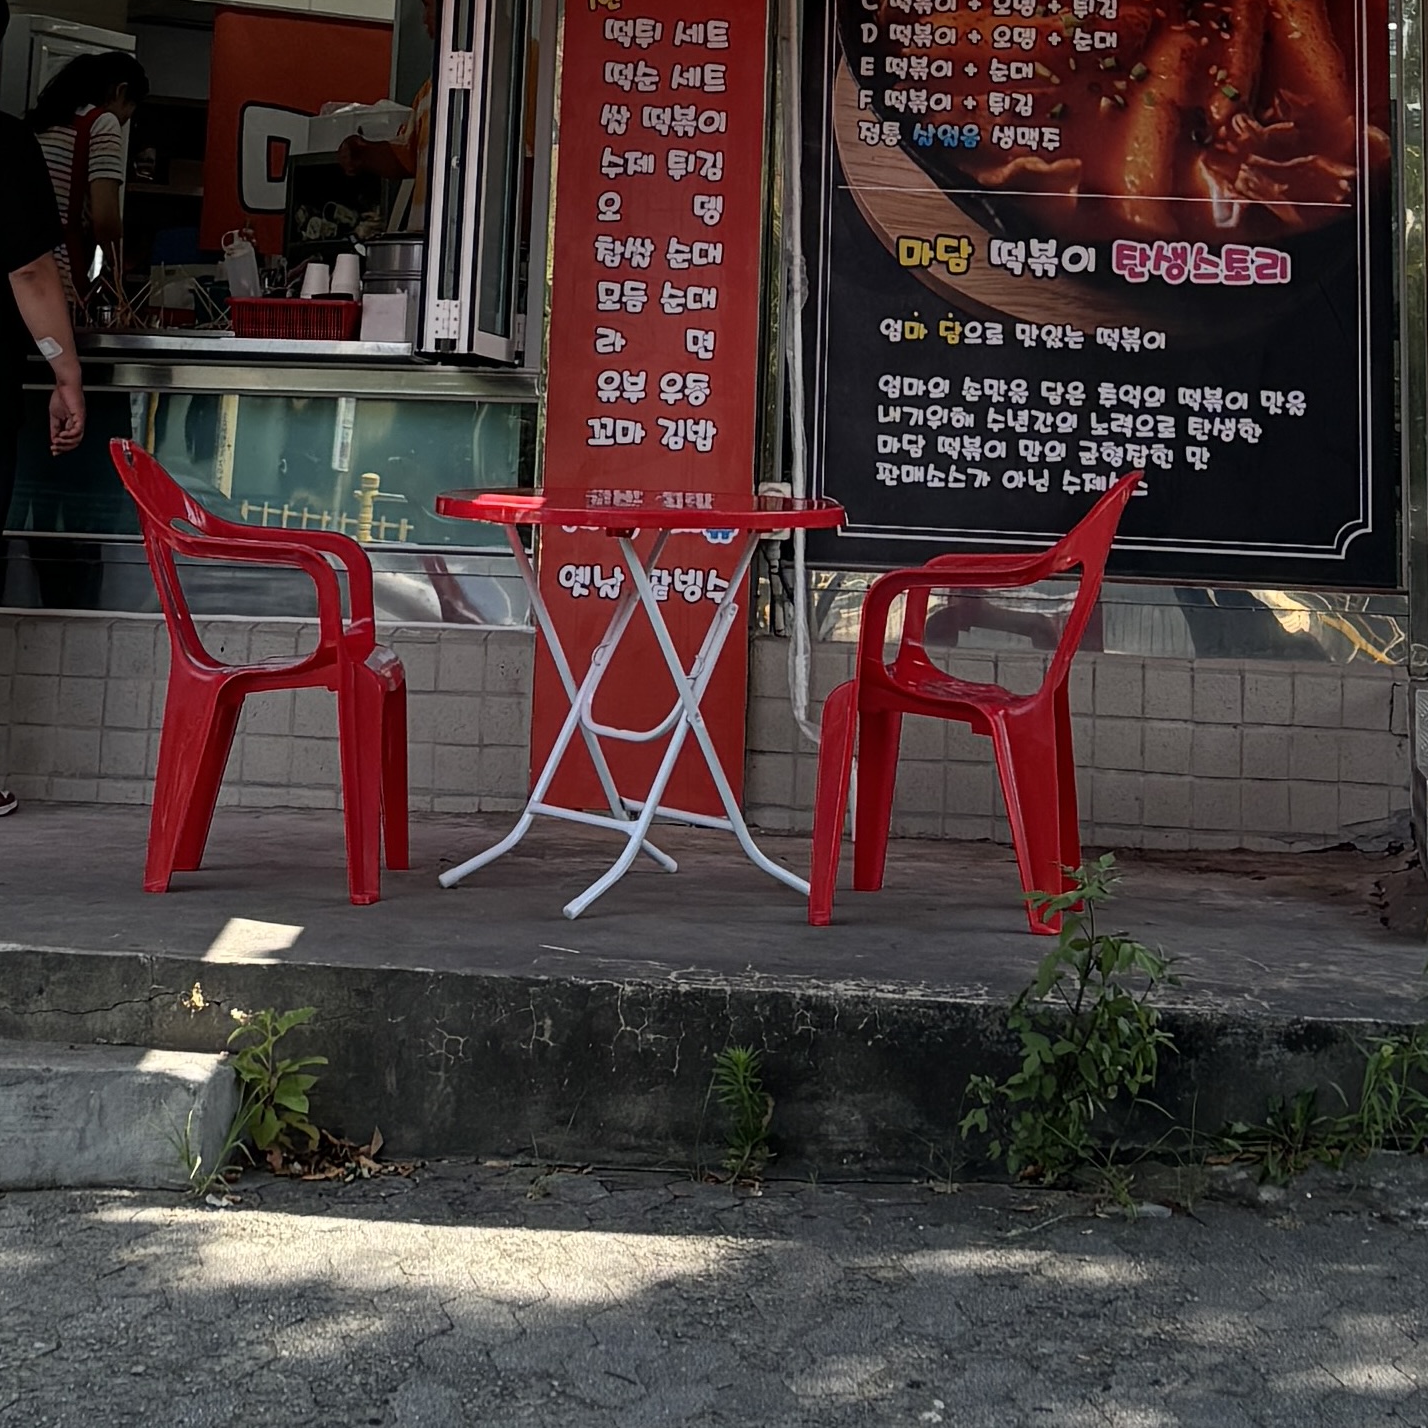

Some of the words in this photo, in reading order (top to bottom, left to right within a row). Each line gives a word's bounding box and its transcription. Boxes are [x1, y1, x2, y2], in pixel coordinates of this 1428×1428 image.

[604, 19, 662, 48] 떡튀
[674, 20, 729, 49] 세트
[861, 23, 878, 43] D
[890, 23, 956, 47] 떡볶이
[992, 26, 1036, 50] 오뎅
[1073, 28, 1117, 52] 순대
[603, 61, 660, 92] 떡순
[671, 63, 727, 93] 세트
[860, 56, 874, 76] E
[885, 56, 952, 80] 떡볶이
[989, 58, 1034, 82] 순대
[860, 89, 873, 110] F
[884, 89, 952, 114] 떡볶이
[988, 92, 1033, 116] 튀김
[601, 104, 630, 135] 쌀
[643, 105, 727, 137] 떡볶이
[858, 121, 901, 145] 정통
[914, 123, 981, 148] 살얼음
[992, 125, 1060, 151] 생맥주
[601, 148, 655, 179] 수제
[667, 150, 723, 181] 튀김
[595, 235, 655, 268] 찹쌀
[666, 236, 723, 269] 순대
[897, 236, 973, 274] 마담
[990, 239, 1096, 278] 떡볶이
[1112, 239, 1291, 285] 탄생스토리
[597, 280, 648, 313] 모듬
[660, 281, 717, 314] 순대
[879, 318, 928, 342] 엄마
[939, 320, 1004, 345] 담으로
[1015, 323, 1084, 349] 맛있는
[1096, 327, 1166, 352] 떡볶이
[597, 369, 646, 403] 유부
[660, 372, 711, 406] 우동
[878, 374, 950, 398] 엄마의
[962, 377, 1029, 404] 손맛을
[1041, 380, 1086, 406] 담은
[1098, 382, 1166, 409] 추억의
[1178, 387, 1248, 412] 떡볶이
[1260, 390, 1307, 416] 맛을
[587, 417, 646, 446] 꼬마
[657, 417, 717, 452] 김밥
[878, 405, 974, 429] 내기위해
[987, 407, 1077, 433] 수년간의
[1090, 412, 1176, 438] 노력으로
[1188, 416, 1262, 444] 탄생한
[877, 434, 925, 458] 마담
[938, 435, 1006, 461] 떡볶이
[1018, 439, 1066, 462] 만의
[1079, 440, 1173, 469] 균형잡힌
[1186, 446, 1210, 471] 맛
[876, 462, 990, 488] 판매소스가
[1002, 469, 1049, 492] 아닌
[558, 564, 625, 599] 옛날
